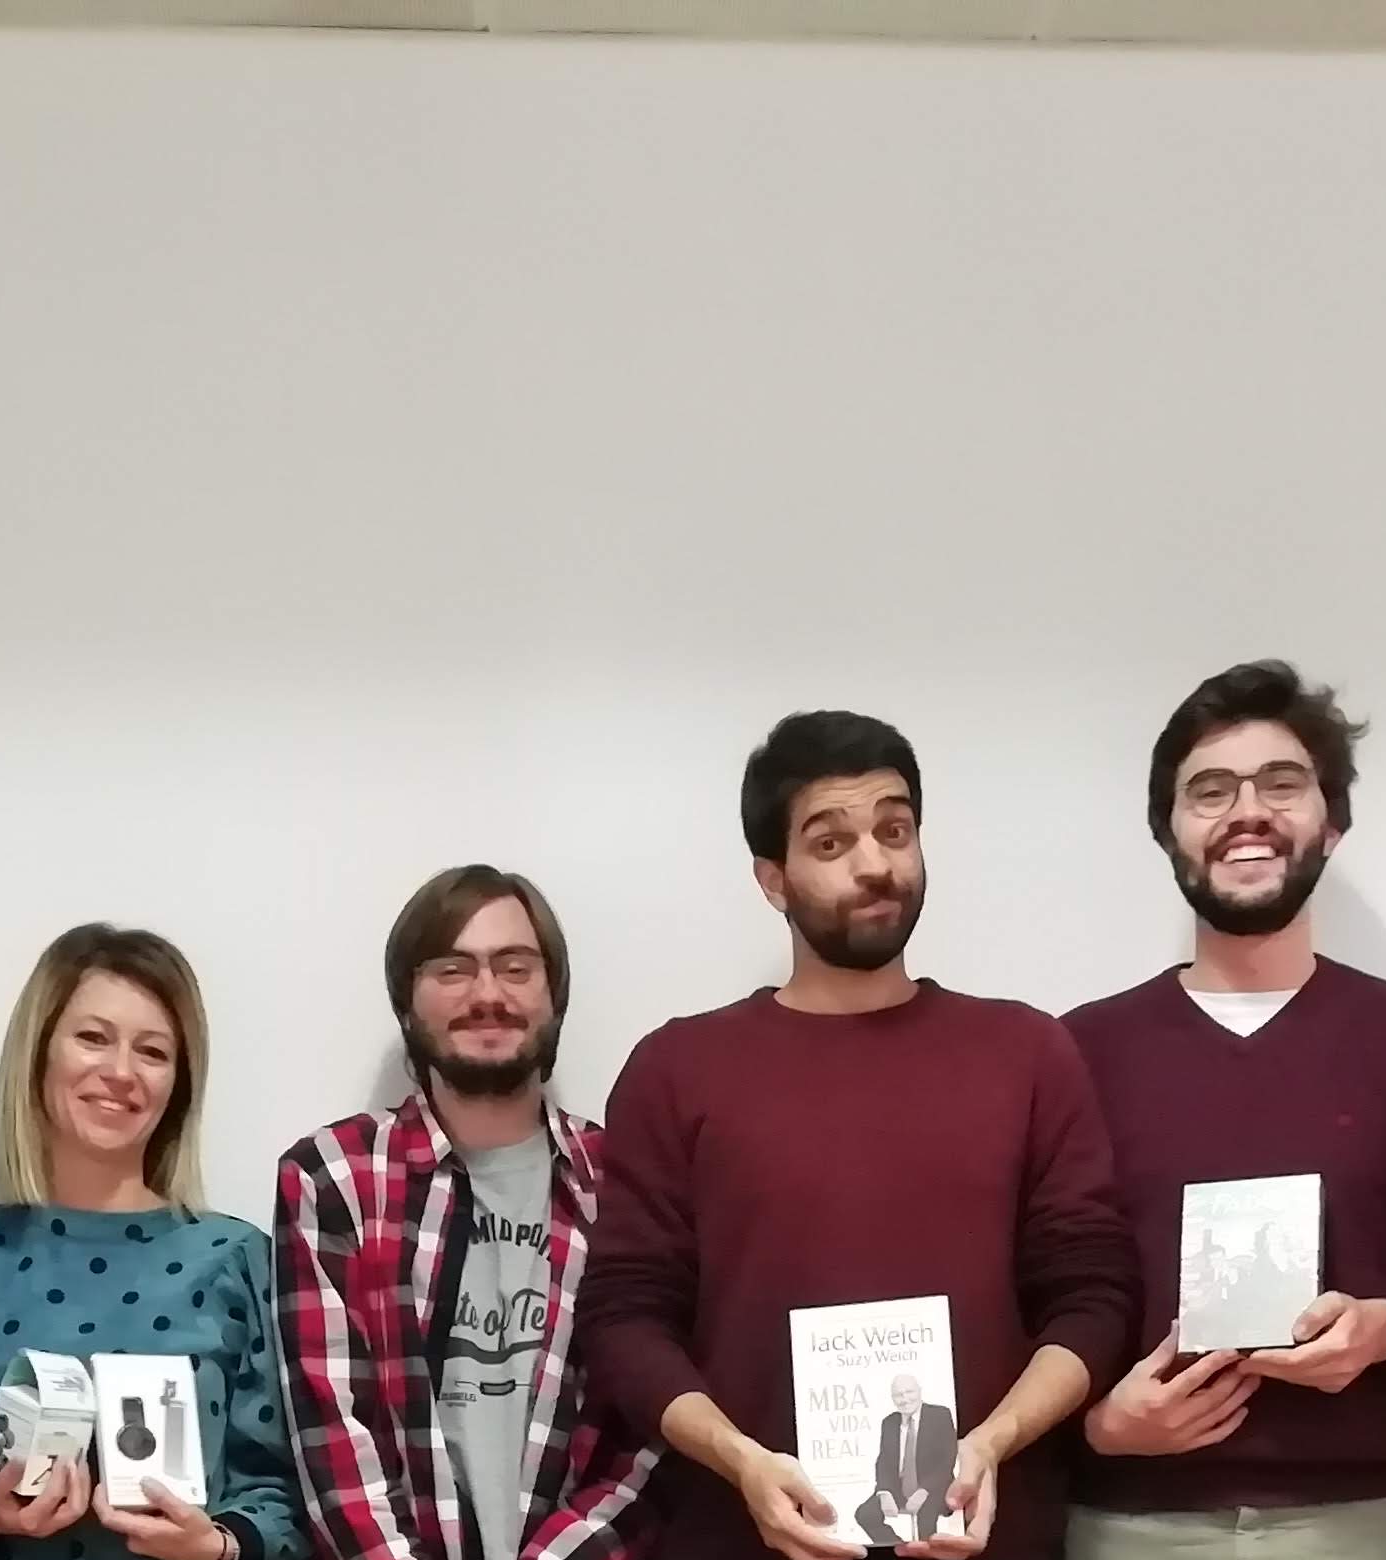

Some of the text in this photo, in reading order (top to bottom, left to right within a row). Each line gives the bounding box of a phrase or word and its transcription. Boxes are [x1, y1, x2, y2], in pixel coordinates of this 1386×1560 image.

[512, 1288, 545, 1332] Te
[809, 1329, 856, 1353] Jack
[837, 1353, 871, 1368] Suzy
[808, 1384, 869, 1412] MBA
[828, 1414, 872, 1433] VIDA
[812, 1438, 866, 1460] REAL
